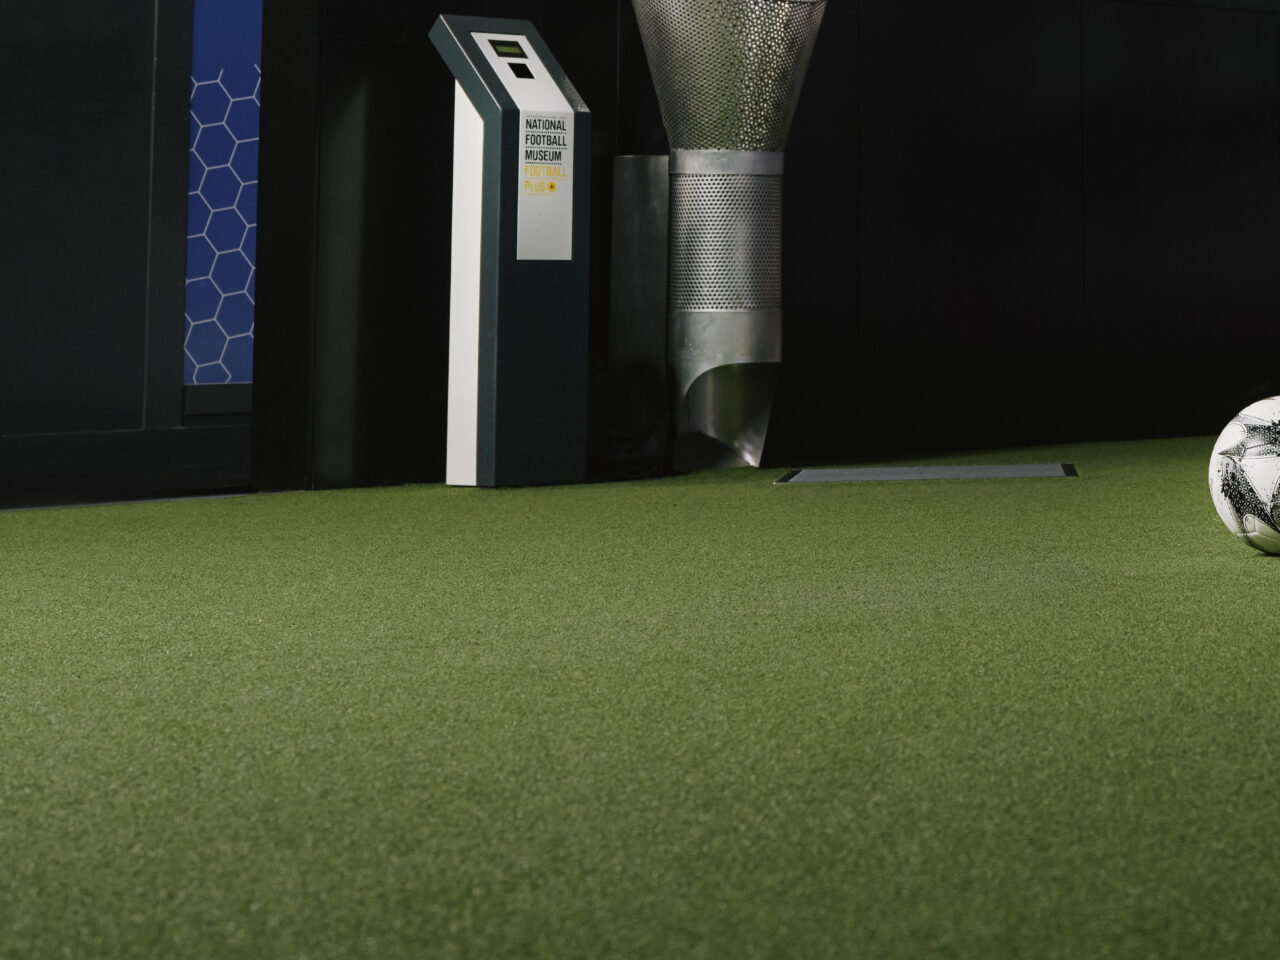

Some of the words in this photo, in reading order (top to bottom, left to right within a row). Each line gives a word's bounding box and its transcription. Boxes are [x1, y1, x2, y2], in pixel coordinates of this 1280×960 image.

[525, 118, 567, 131] NATIONAL
[525, 134, 567, 146] FOOTBALL
[525, 149, 562, 161] MUSEUM
[524, 165, 568, 177] FOOTBALL
[524, 180, 546, 192] PLUS
